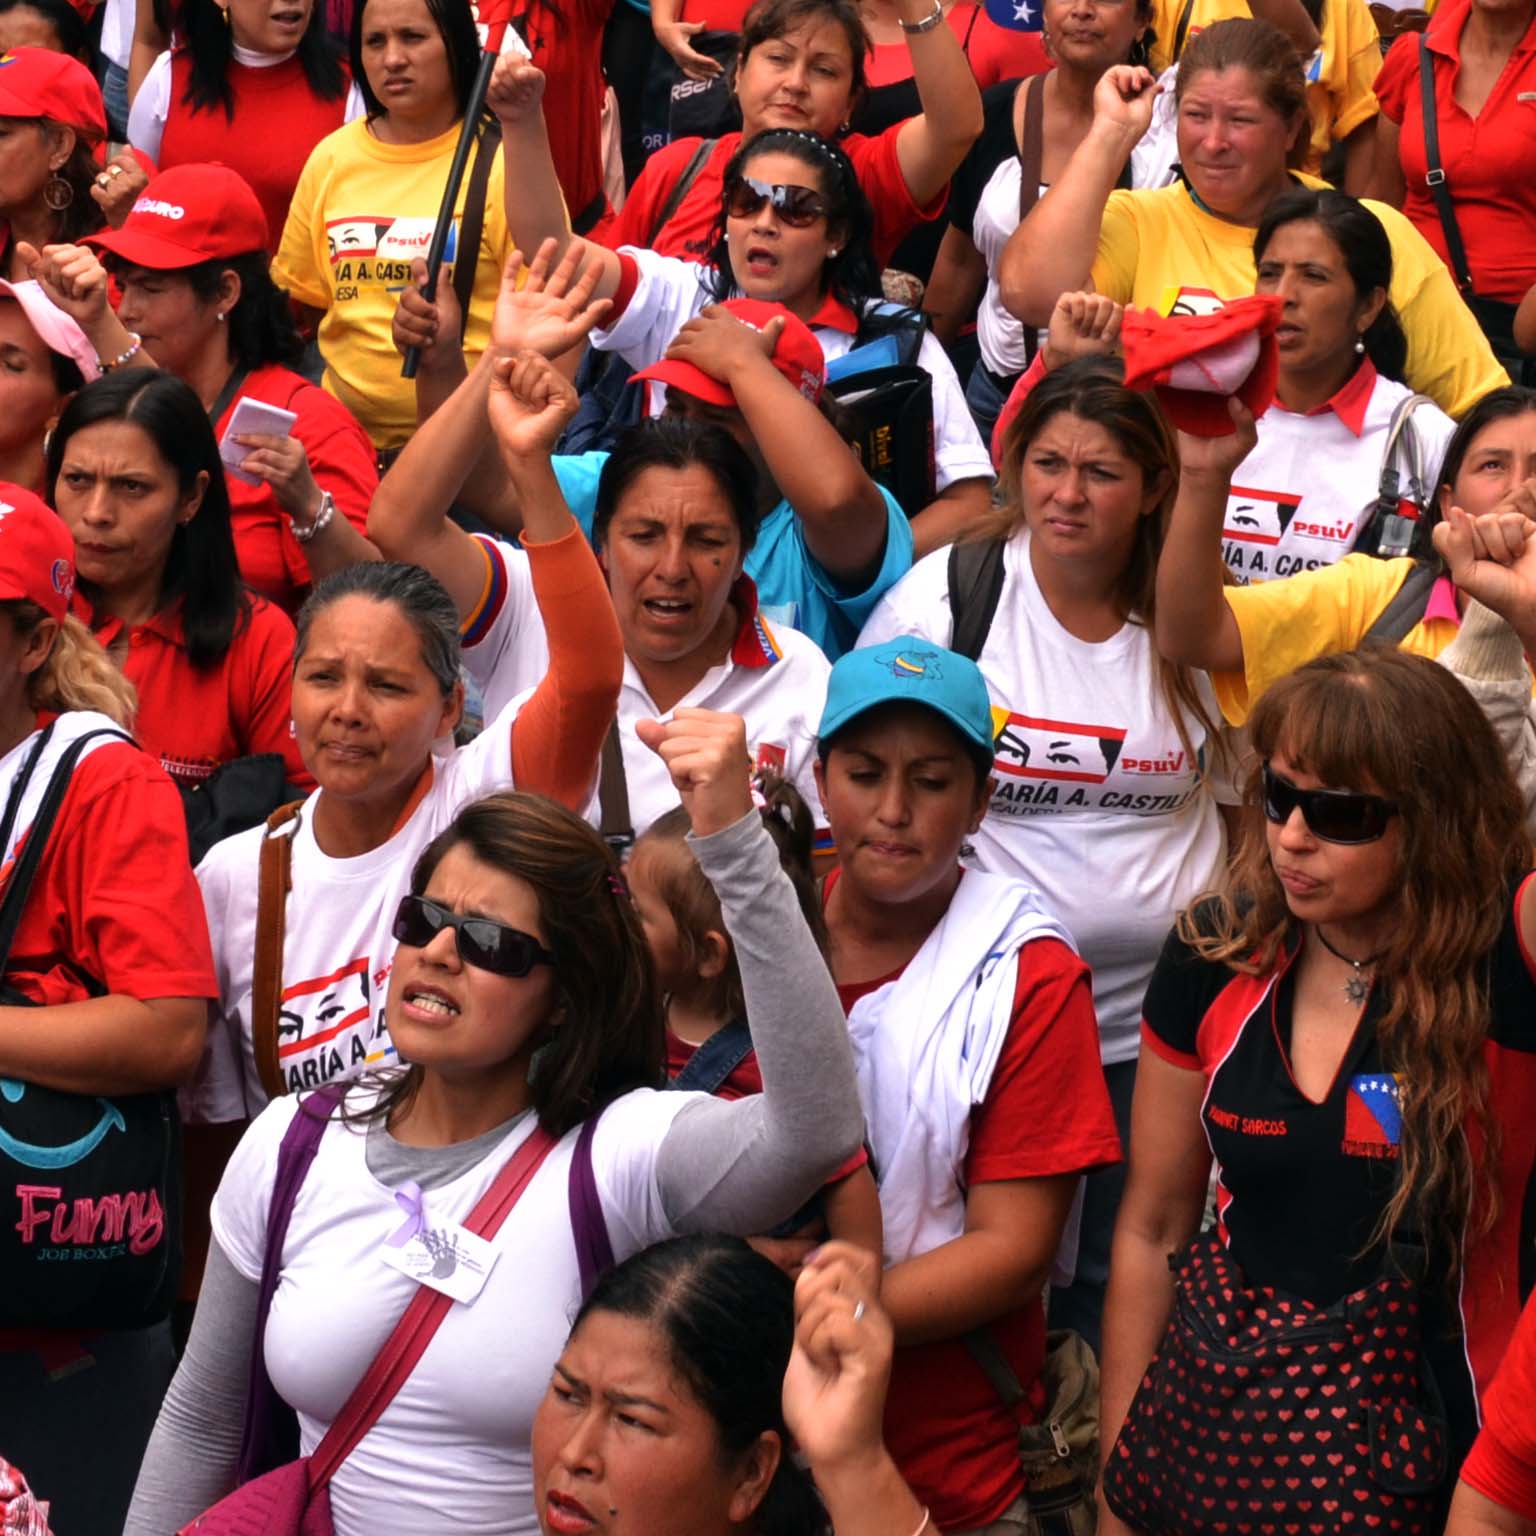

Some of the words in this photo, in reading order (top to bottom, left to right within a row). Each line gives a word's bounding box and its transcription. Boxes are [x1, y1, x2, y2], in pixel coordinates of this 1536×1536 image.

[357, 262, 373, 281] A.
[1249, 550, 1270, 573] A.
[1064, 787, 1093, 808] A.
[14, 1181, 166, 1257] Funny
[37, 1247, 67, 1262] JOE
